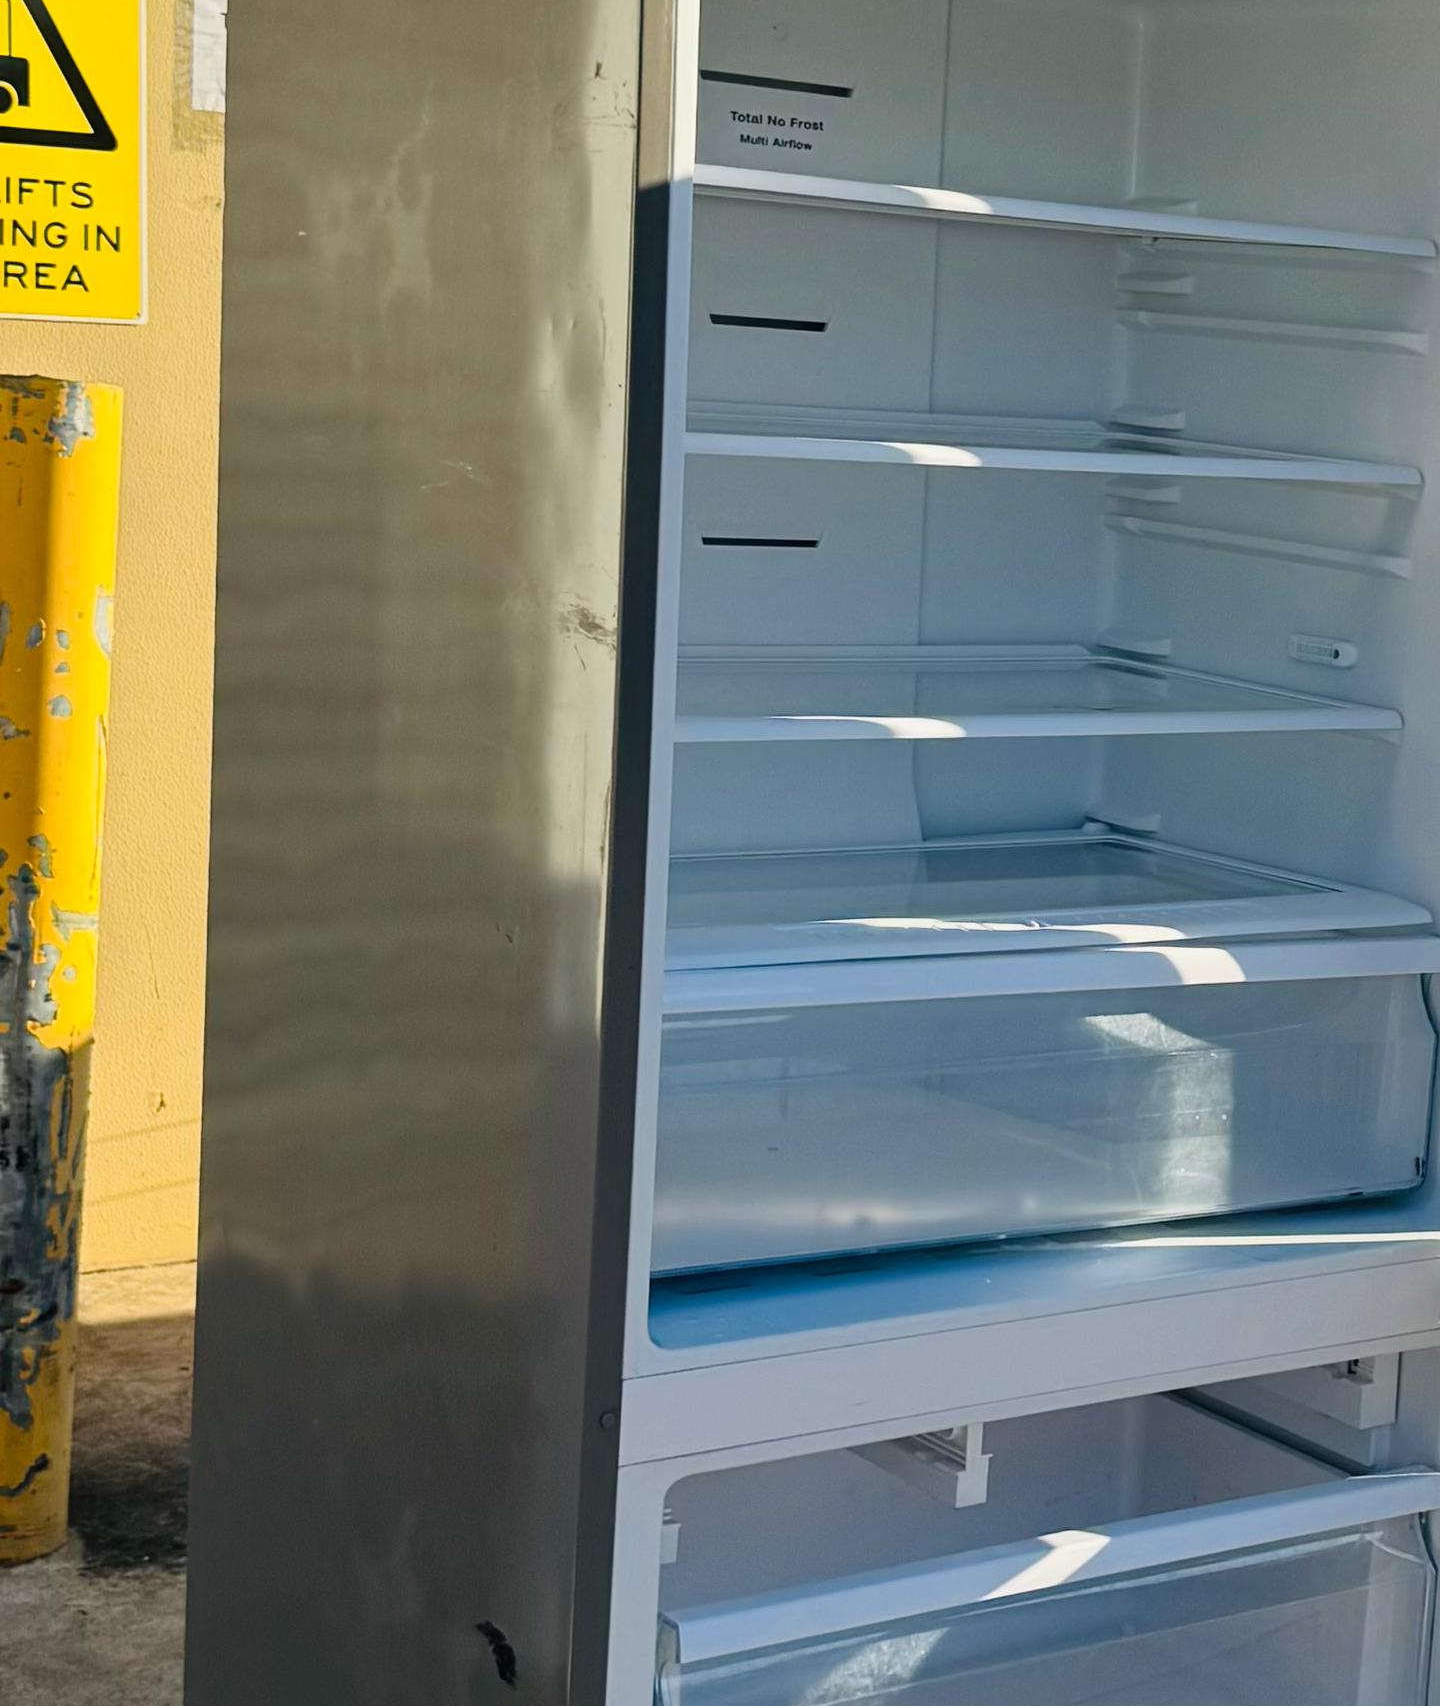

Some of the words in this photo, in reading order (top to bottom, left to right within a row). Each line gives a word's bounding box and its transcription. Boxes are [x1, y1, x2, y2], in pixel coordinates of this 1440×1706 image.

[730, 110, 763, 125] Total
[767, 115, 786, 127] No
[790, 117, 824, 132] Frost
[740, 134, 768, 146] Multi
[772, 137, 812, 150] Airflow
[0, 176, 94, 209] IFTS
[83, 223, 121, 253] IN
[3, 260, 90, 292] REA
